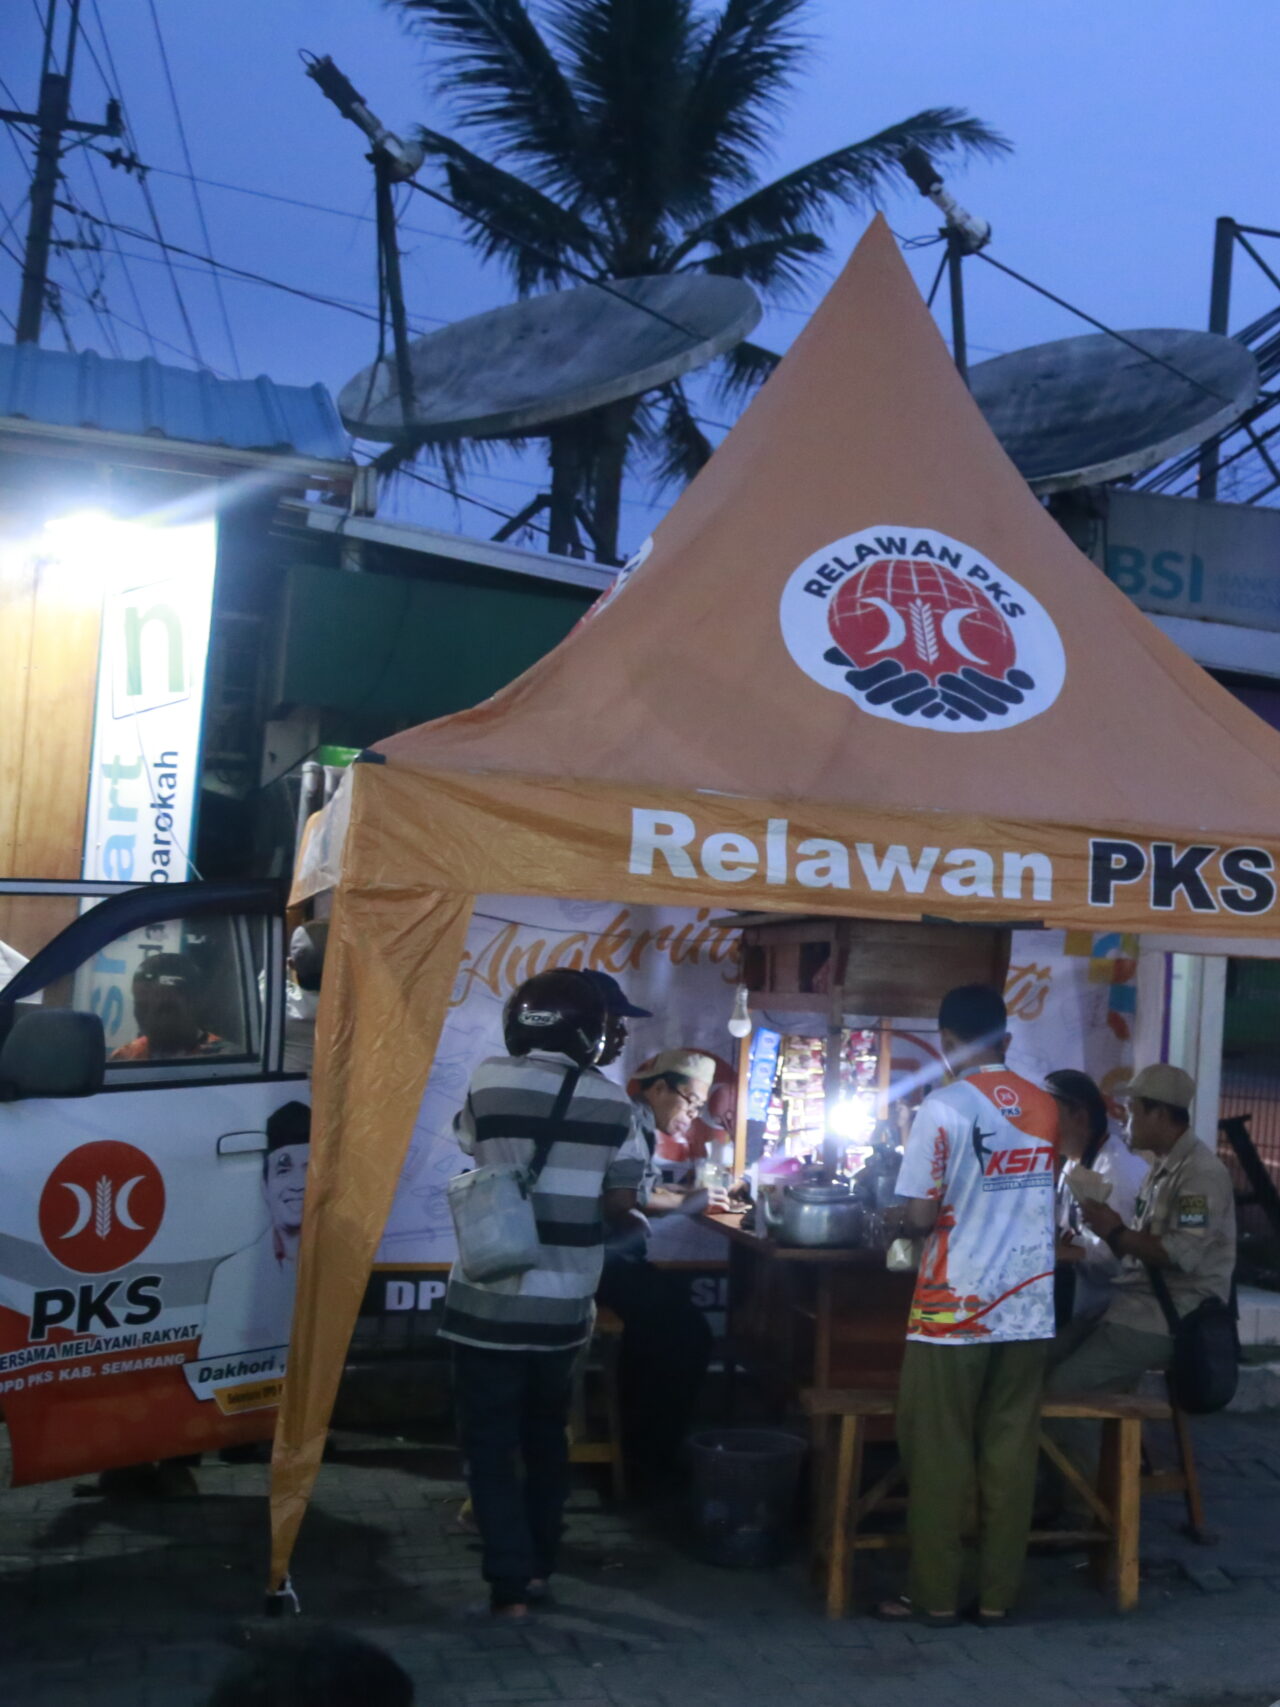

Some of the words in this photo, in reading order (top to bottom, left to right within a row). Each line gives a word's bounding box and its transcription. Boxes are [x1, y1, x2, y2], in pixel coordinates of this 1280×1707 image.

[803, 537, 962, 599] RELAWAN
[967, 564, 1026, 619] PKS
[1108, 545, 1205, 602] BSI
[628, 807, 1053, 900] Relawan
[1089, 838, 1276, 915] PKS
[1001, 1106, 1021, 1117] PKS
[29, 1275, 163, 1341] PKS
[61, 1335, 138, 1358] MELAYANI
[142, 1324, 199, 1345] RAKYAT
[28, 1370, 54, 1388] PKS
[58, 1365, 96, 1381] KAB.
[101, 1353, 186, 1375] SEMARANG
[197, 1354, 277, 1383] Dakhori
